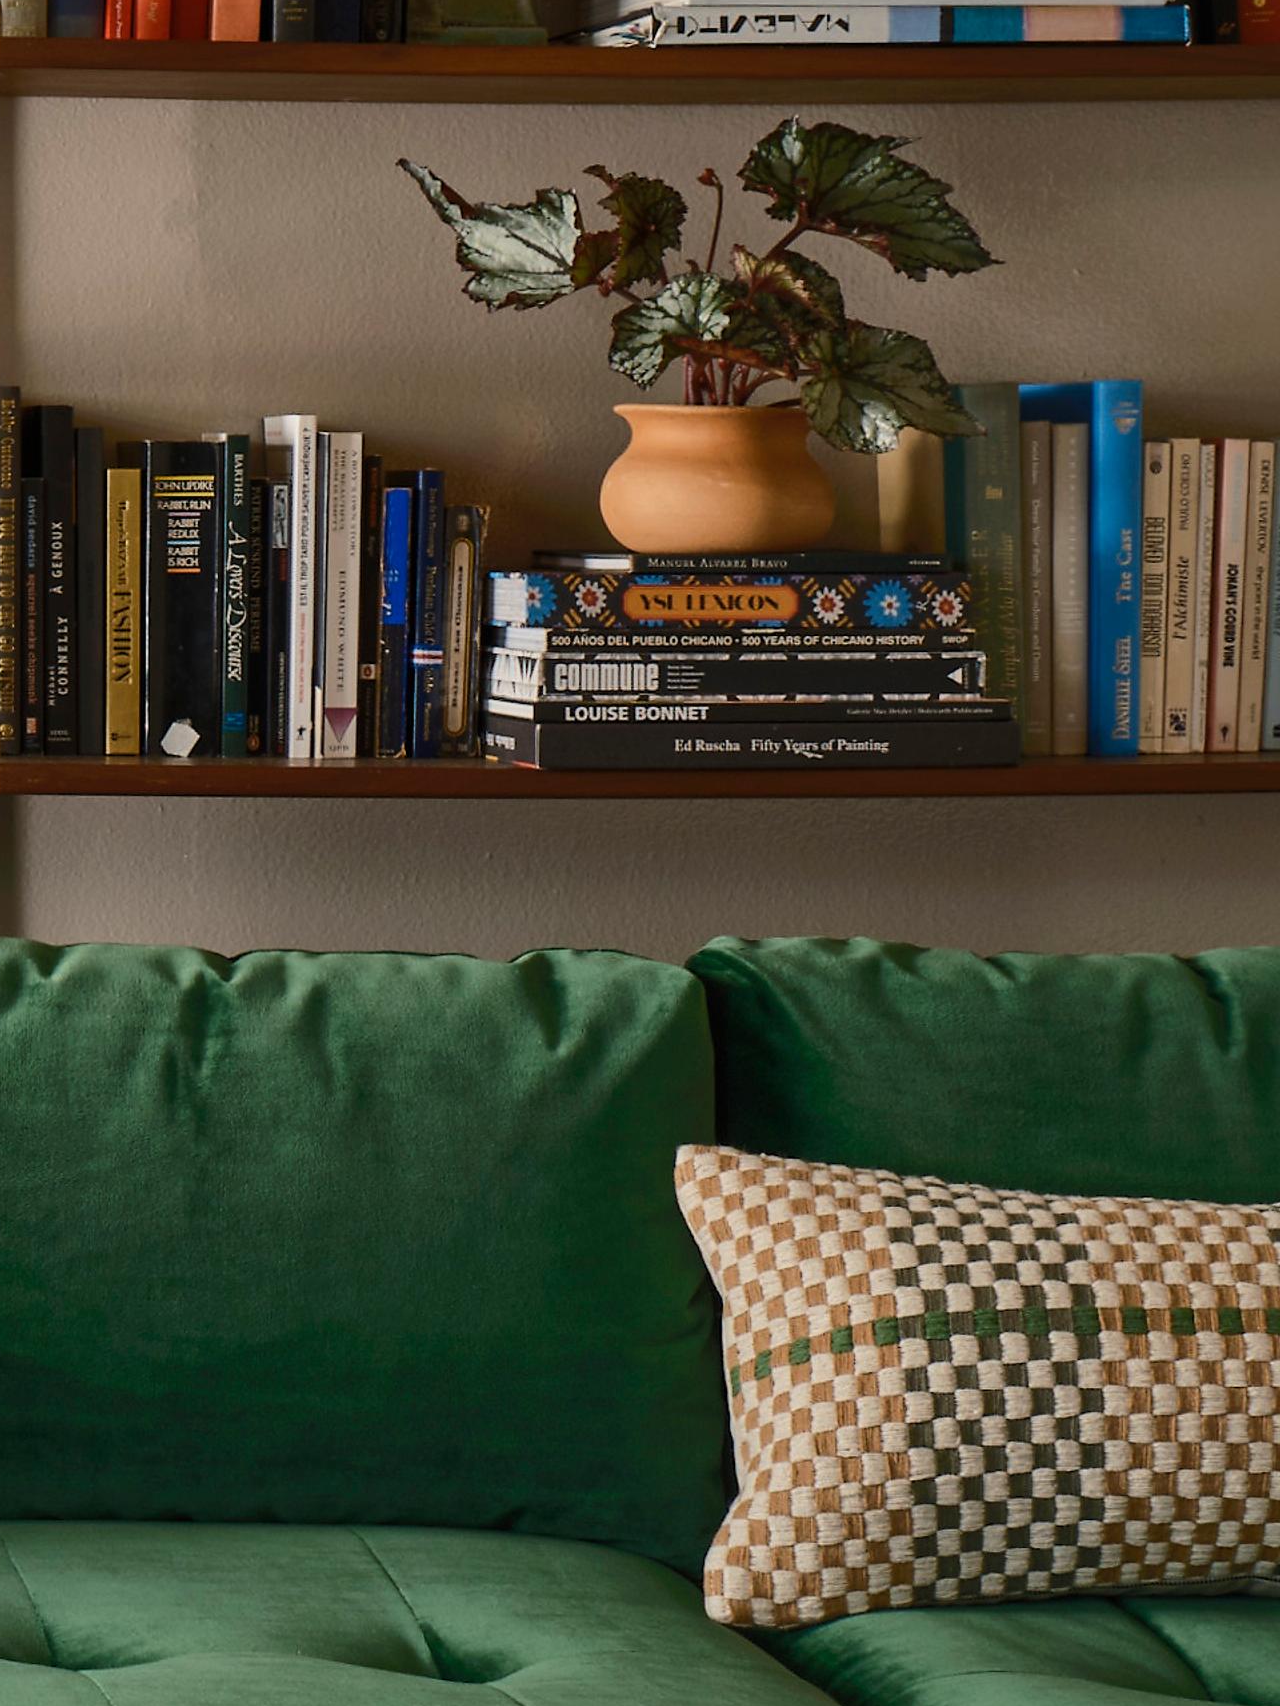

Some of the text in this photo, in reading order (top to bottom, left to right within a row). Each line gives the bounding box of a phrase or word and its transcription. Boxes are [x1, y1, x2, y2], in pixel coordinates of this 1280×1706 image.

[155, 481, 214, 491] JOHN UPDIKE
[233, 453, 244, 506] BARTHES
[1179, 453, 1191, 531] PAULO COELHO
[26, 494, 37, 568] david sedaris
[168, 518, 200, 527] RABBIT
[168, 546, 200, 556] RABBIT
[647, 557, 788, 569] MANUEL ALVAREZ BRAVO
[1115, 528, 1133, 604] The Cast
[639, 593, 780, 610] YSL LEXICON
[1142, 516, 1166, 658] BELOVED TONI MORRISON
[26, 573, 38, 703] squirrel seeks chipmunk
[112, 589, 133, 685] FASHION
[336, 569, 347, 693] EDMUND WHITE
[551, 636, 570, 646] 500
[607, 636, 629, 647] DEL
[630, 636, 679, 647] PUEBLO
[681, 636, 733, 647] CHICANO
[742, 635, 925, 646] 500 YEARS OF CHICANO HISTORY
[57, 616, 68, 696] CONNELLY
[554, 662, 660, 691] commune
[1111, 635, 1132, 740] DANIELLE STEEL
[564, 705, 709, 721] LOUISE BONNET
[673, 738, 741, 752] Ed Ruscha
[750, 738, 890, 754] Fifty Years of Painting
